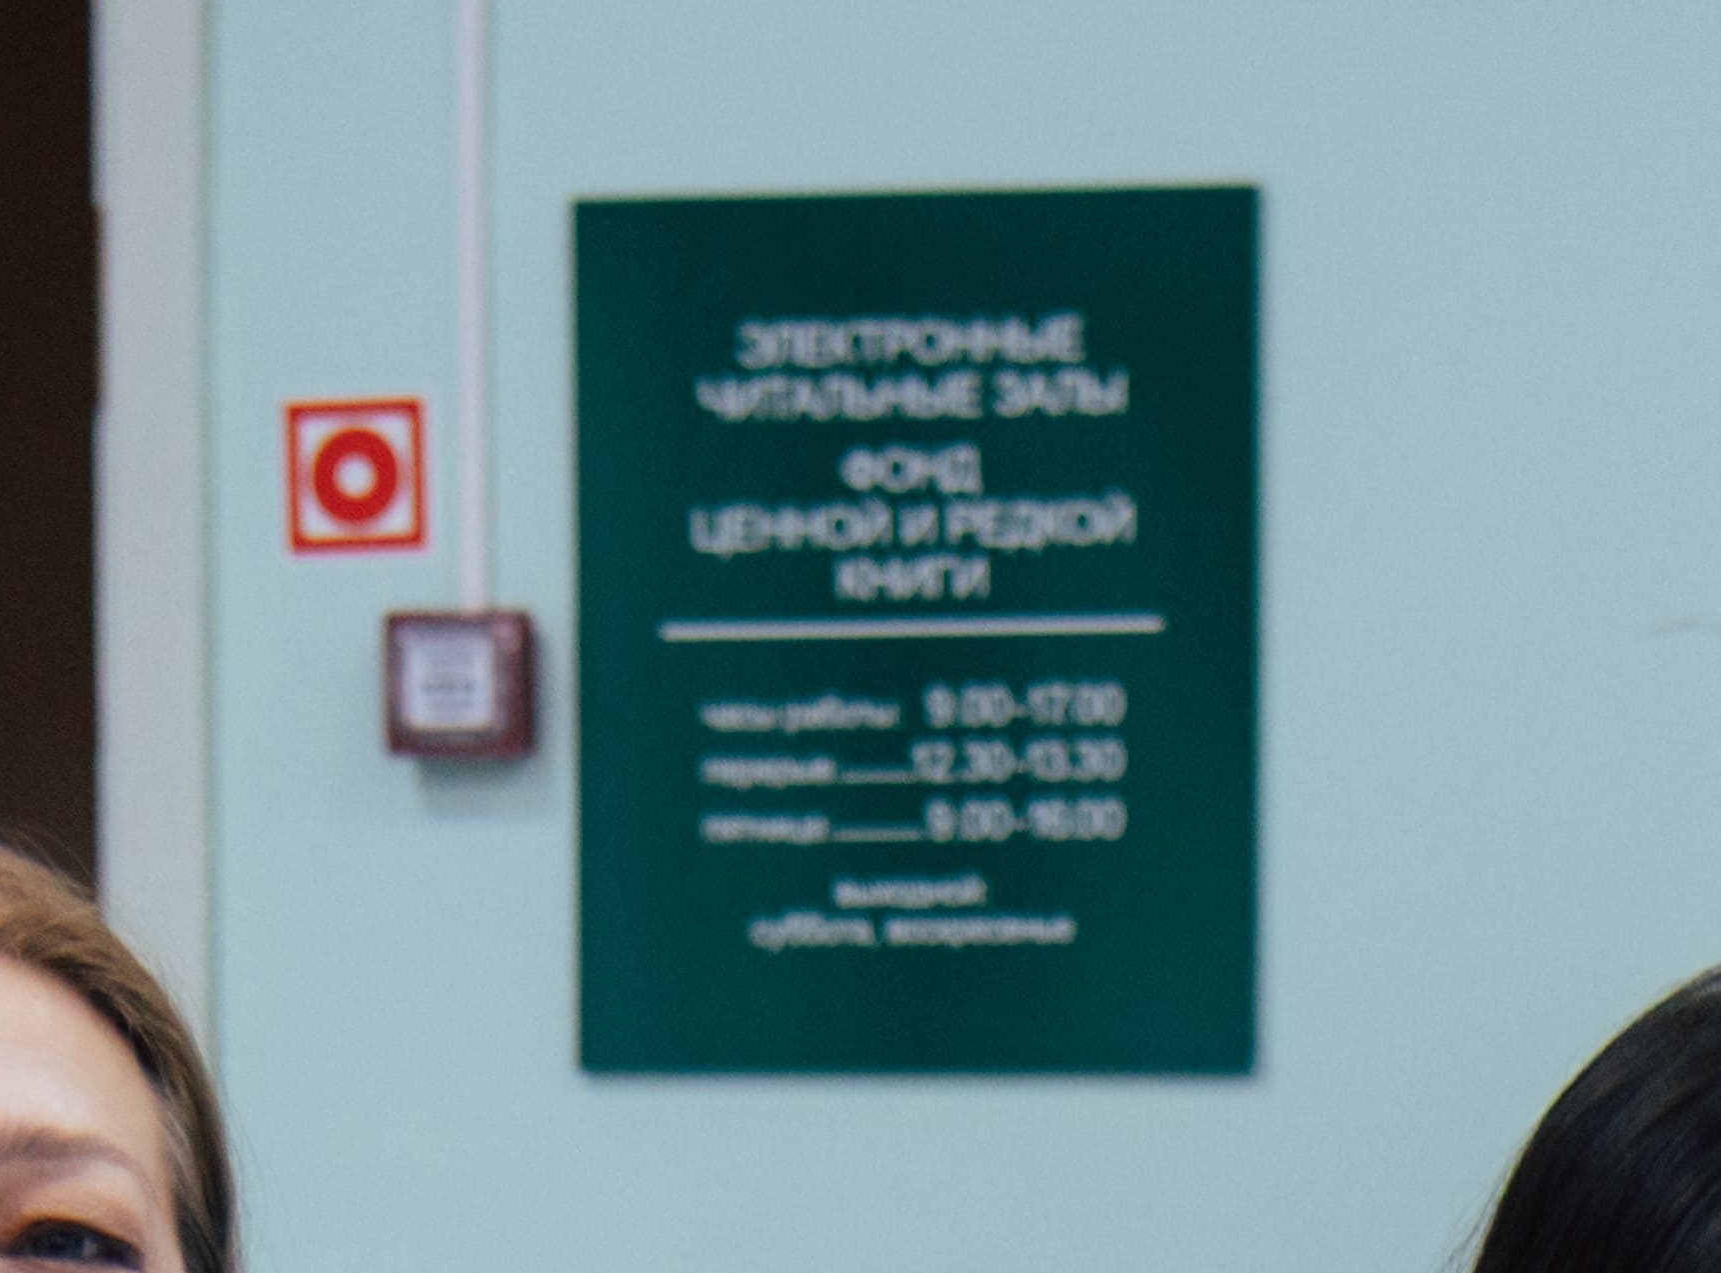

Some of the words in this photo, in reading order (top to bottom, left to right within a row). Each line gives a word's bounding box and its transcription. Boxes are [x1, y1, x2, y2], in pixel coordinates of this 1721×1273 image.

[738, 316, 1085, 369] ЭЛЕКТРОННЫЕ
[697, 371, 981, 420] ЧИТАЛЬНЫЕ
[993, 368, 1128, 416] ЗАЛЫ
[840, 444, 982, 493] ФОНД
[691, 500, 892, 558] ЦЕННОЙ
[899, 506, 939, 545] И
[946, 490, 1136, 550] РЕДКОЙ
[835, 554, 989, 600] КНИГИ
[913, 738, 1126, 784] 12.30-13.30
